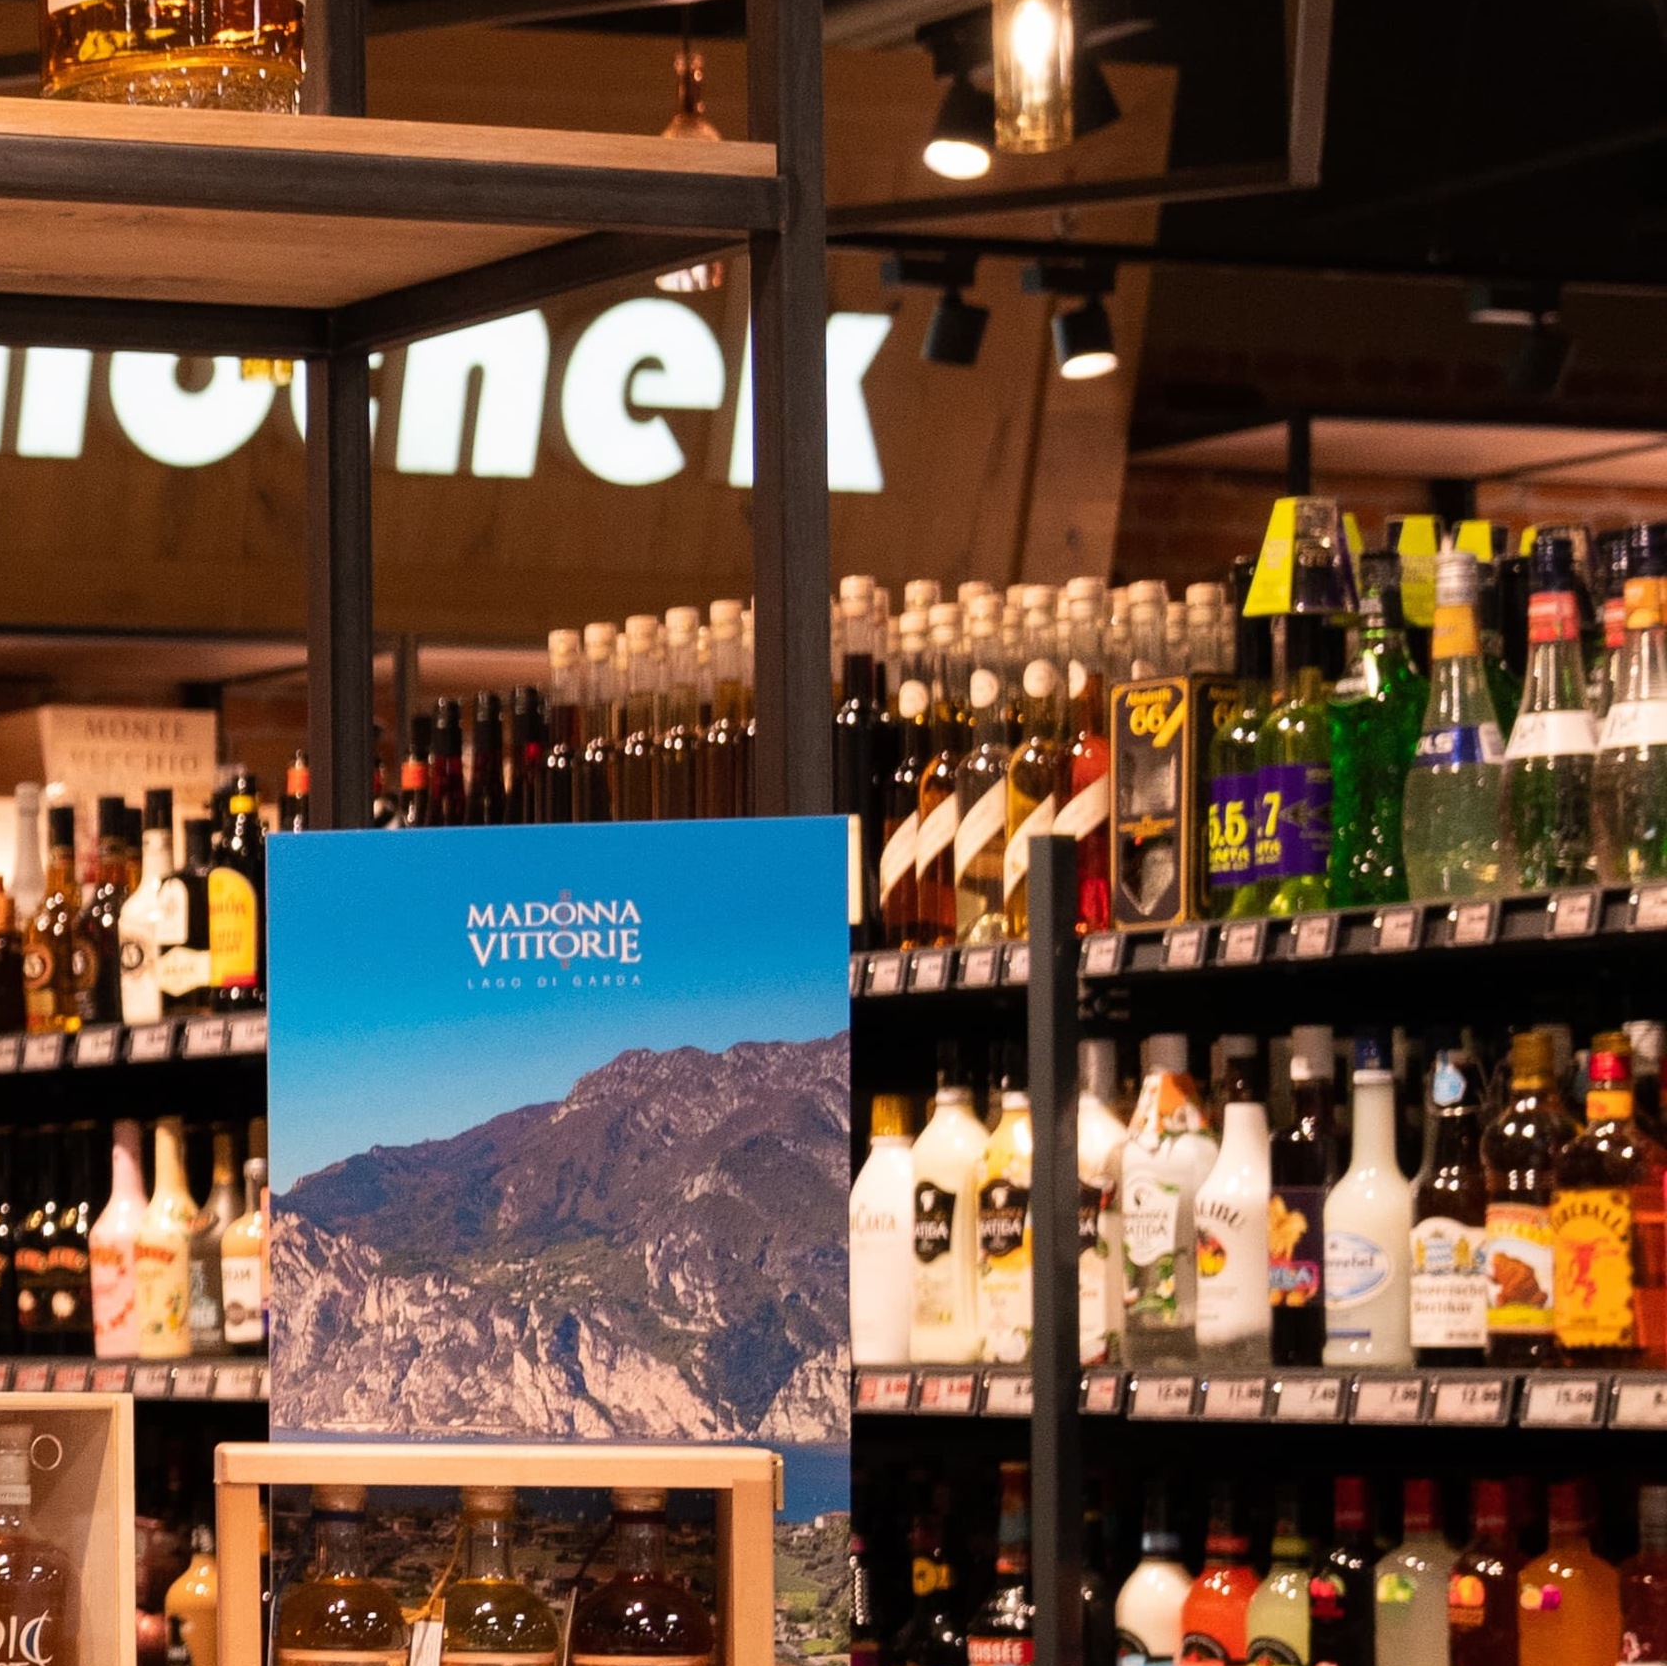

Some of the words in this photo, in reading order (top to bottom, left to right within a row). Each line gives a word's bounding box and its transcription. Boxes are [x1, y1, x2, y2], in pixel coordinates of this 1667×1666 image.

[1129, 706, 1169, 736] 66
[467, 899, 642, 929] MADONNA
[467, 928, 642, 968] VITTORIE
[467, 977, 522, 991] LAGO
[537, 975, 557, 989] DI
[572, 974, 642, 988] GARDA
